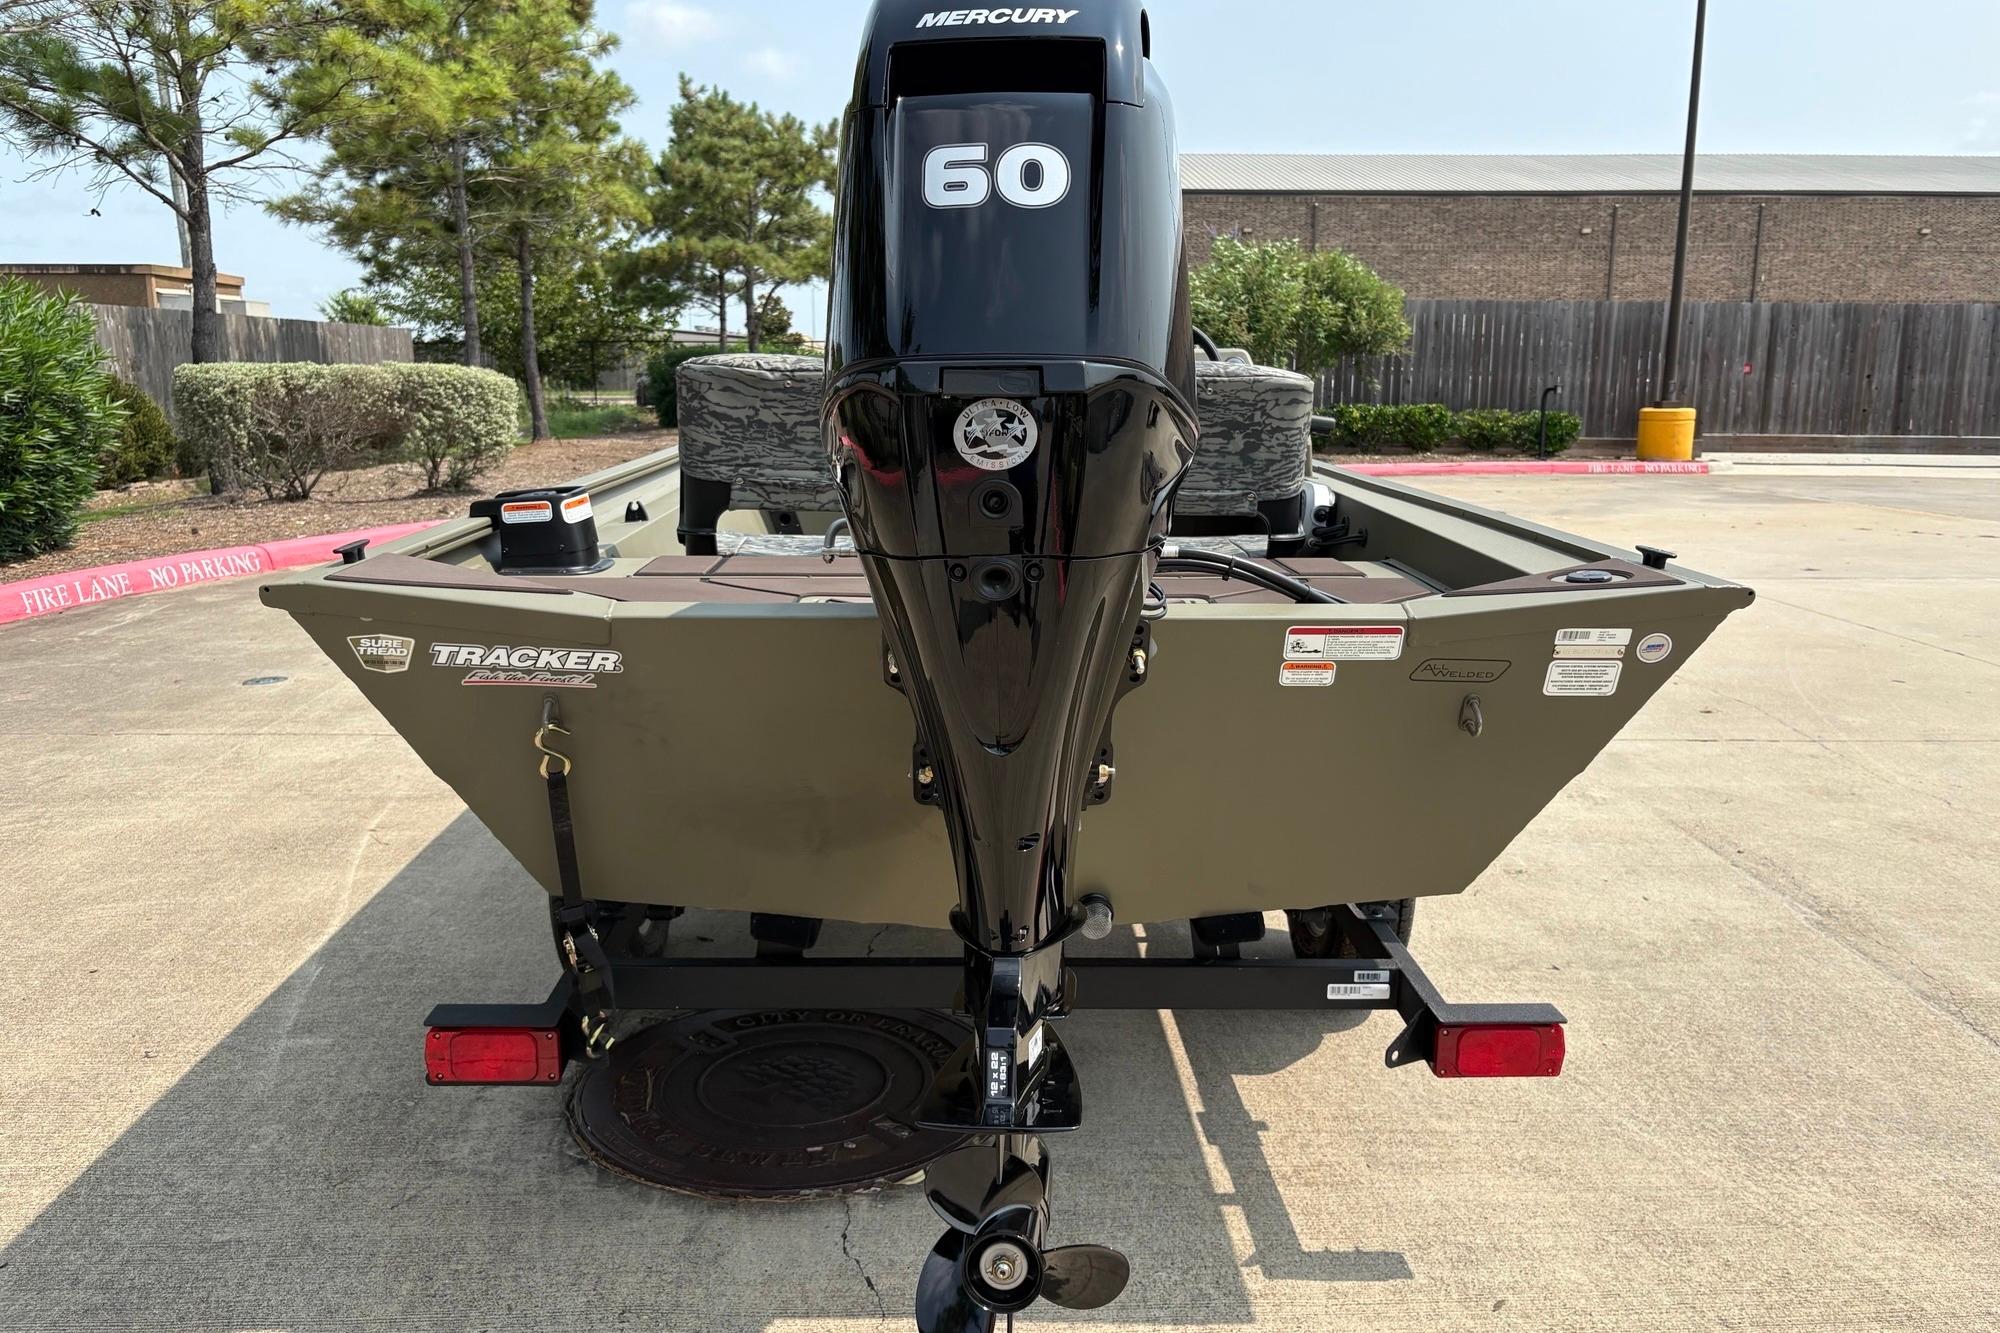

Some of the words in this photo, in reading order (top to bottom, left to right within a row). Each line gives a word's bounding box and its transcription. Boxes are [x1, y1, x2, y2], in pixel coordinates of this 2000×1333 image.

[915, 8, 1079, 28] MERCURY
[921, 142, 1071, 209] 60
[962, 400, 996, 419] ULTRA
[1006, 401, 1029, 418] LOW
[1588, 463, 1606, 473] FIRE
[1611, 463, 1635, 473] LANE
[1645, 463, 1659, 473] NO
[1660, 463, 1702, 473] PARKING
[20, 583, 72, 614] FIRE
[73, 572, 134, 603] LANE
[148, 565, 178, 589] NO
[180, 551, 261, 583] PARKING
[357, 646, 408, 656] TREAD
[360, 639, 403, 648] SURE
[1421, 663, 1449, 672] ALL
[1432, 670, 1494, 678] WELDED
[467, 671, 499, 681] Fish
[504, 672, 526, 681] the
[735, 1010, 808, 1027] CITY
[825, 1011, 867, 1023] OF
[990, 1052, 999, 1069] 22
[990, 1081, 999, 1097] 12
